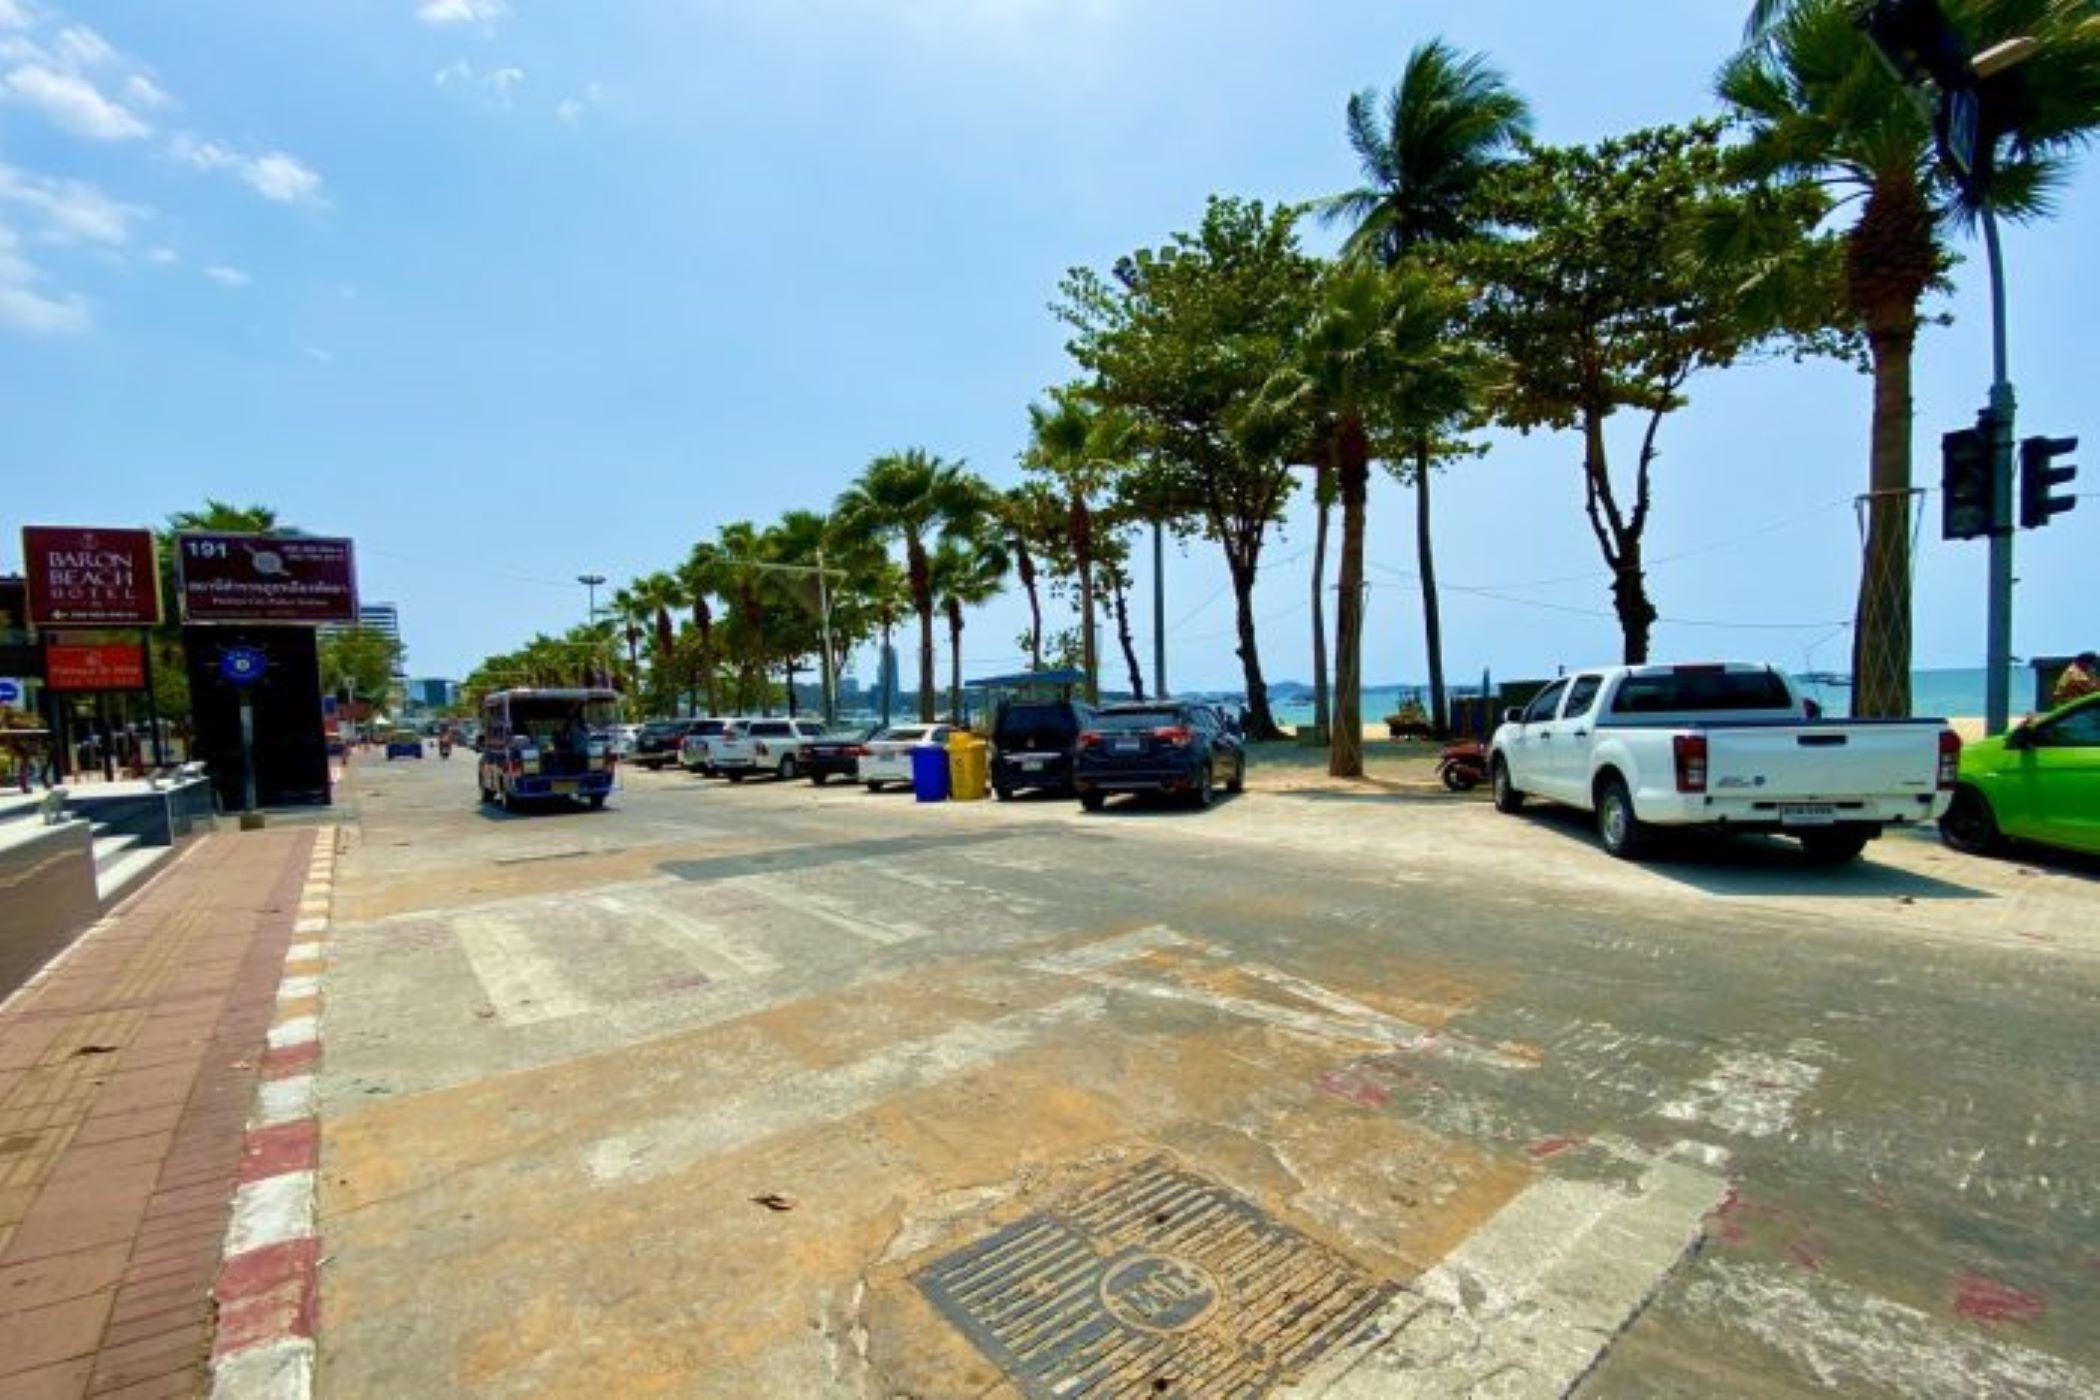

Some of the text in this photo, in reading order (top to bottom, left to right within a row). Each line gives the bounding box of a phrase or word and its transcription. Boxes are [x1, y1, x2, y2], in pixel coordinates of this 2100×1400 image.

[187, 541, 227, 558] 191
[48, 551, 133, 568] BARON
[48, 568, 133, 587] BEACH
[49, 588, 137, 600] HOTEL
